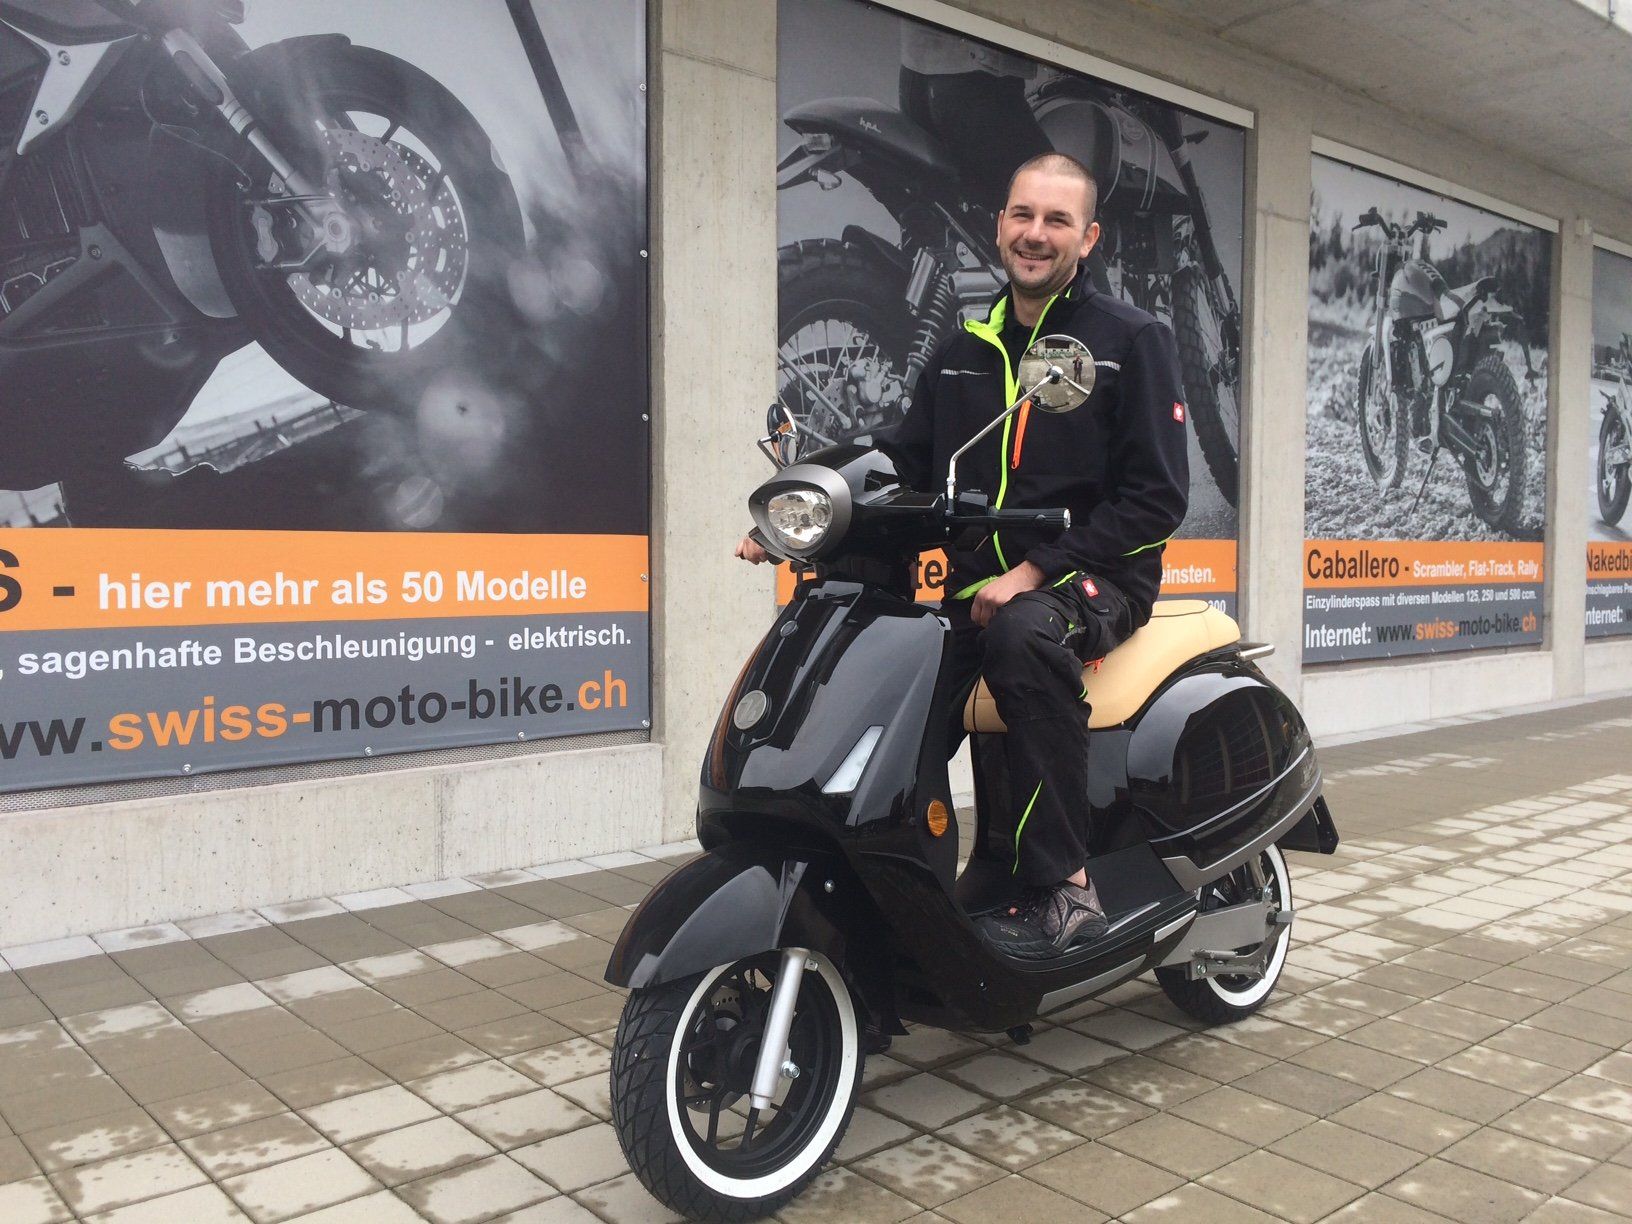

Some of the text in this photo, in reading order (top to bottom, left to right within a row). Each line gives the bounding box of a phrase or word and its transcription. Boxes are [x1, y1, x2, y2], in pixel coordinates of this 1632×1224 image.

[1307, 548, 1400, 579] Caballero
[1413, 559, 1467, 579] Scrambler,
[1468, 559, 1516, 579] Flat-Track,
[1517, 559, 1539, 580] Rally
[98, 572, 191, 610] hier
[206, 573, 318, 608] mehr
[331, 571, 389, 605] als
[401, 571, 444, 604] 50
[457, 569, 588, 603] Modelle
[1306, 594, 1380, 612] Einzylinderspass
[1381, 593, 1396, 606] mit
[1396, 592, 1431, 606] diversen
[1431, 590, 1465, 604] Modellen
[1495, 589, 1508, 601] und
[1305, 608, 1537, 648] Internet: www.swiss-moto-bike.ch
[18, 639, 222, 680] sagenhafte
[235, 631, 477, 666] Beschleunigung
[508, 624, 632, 652] elektrisch.
